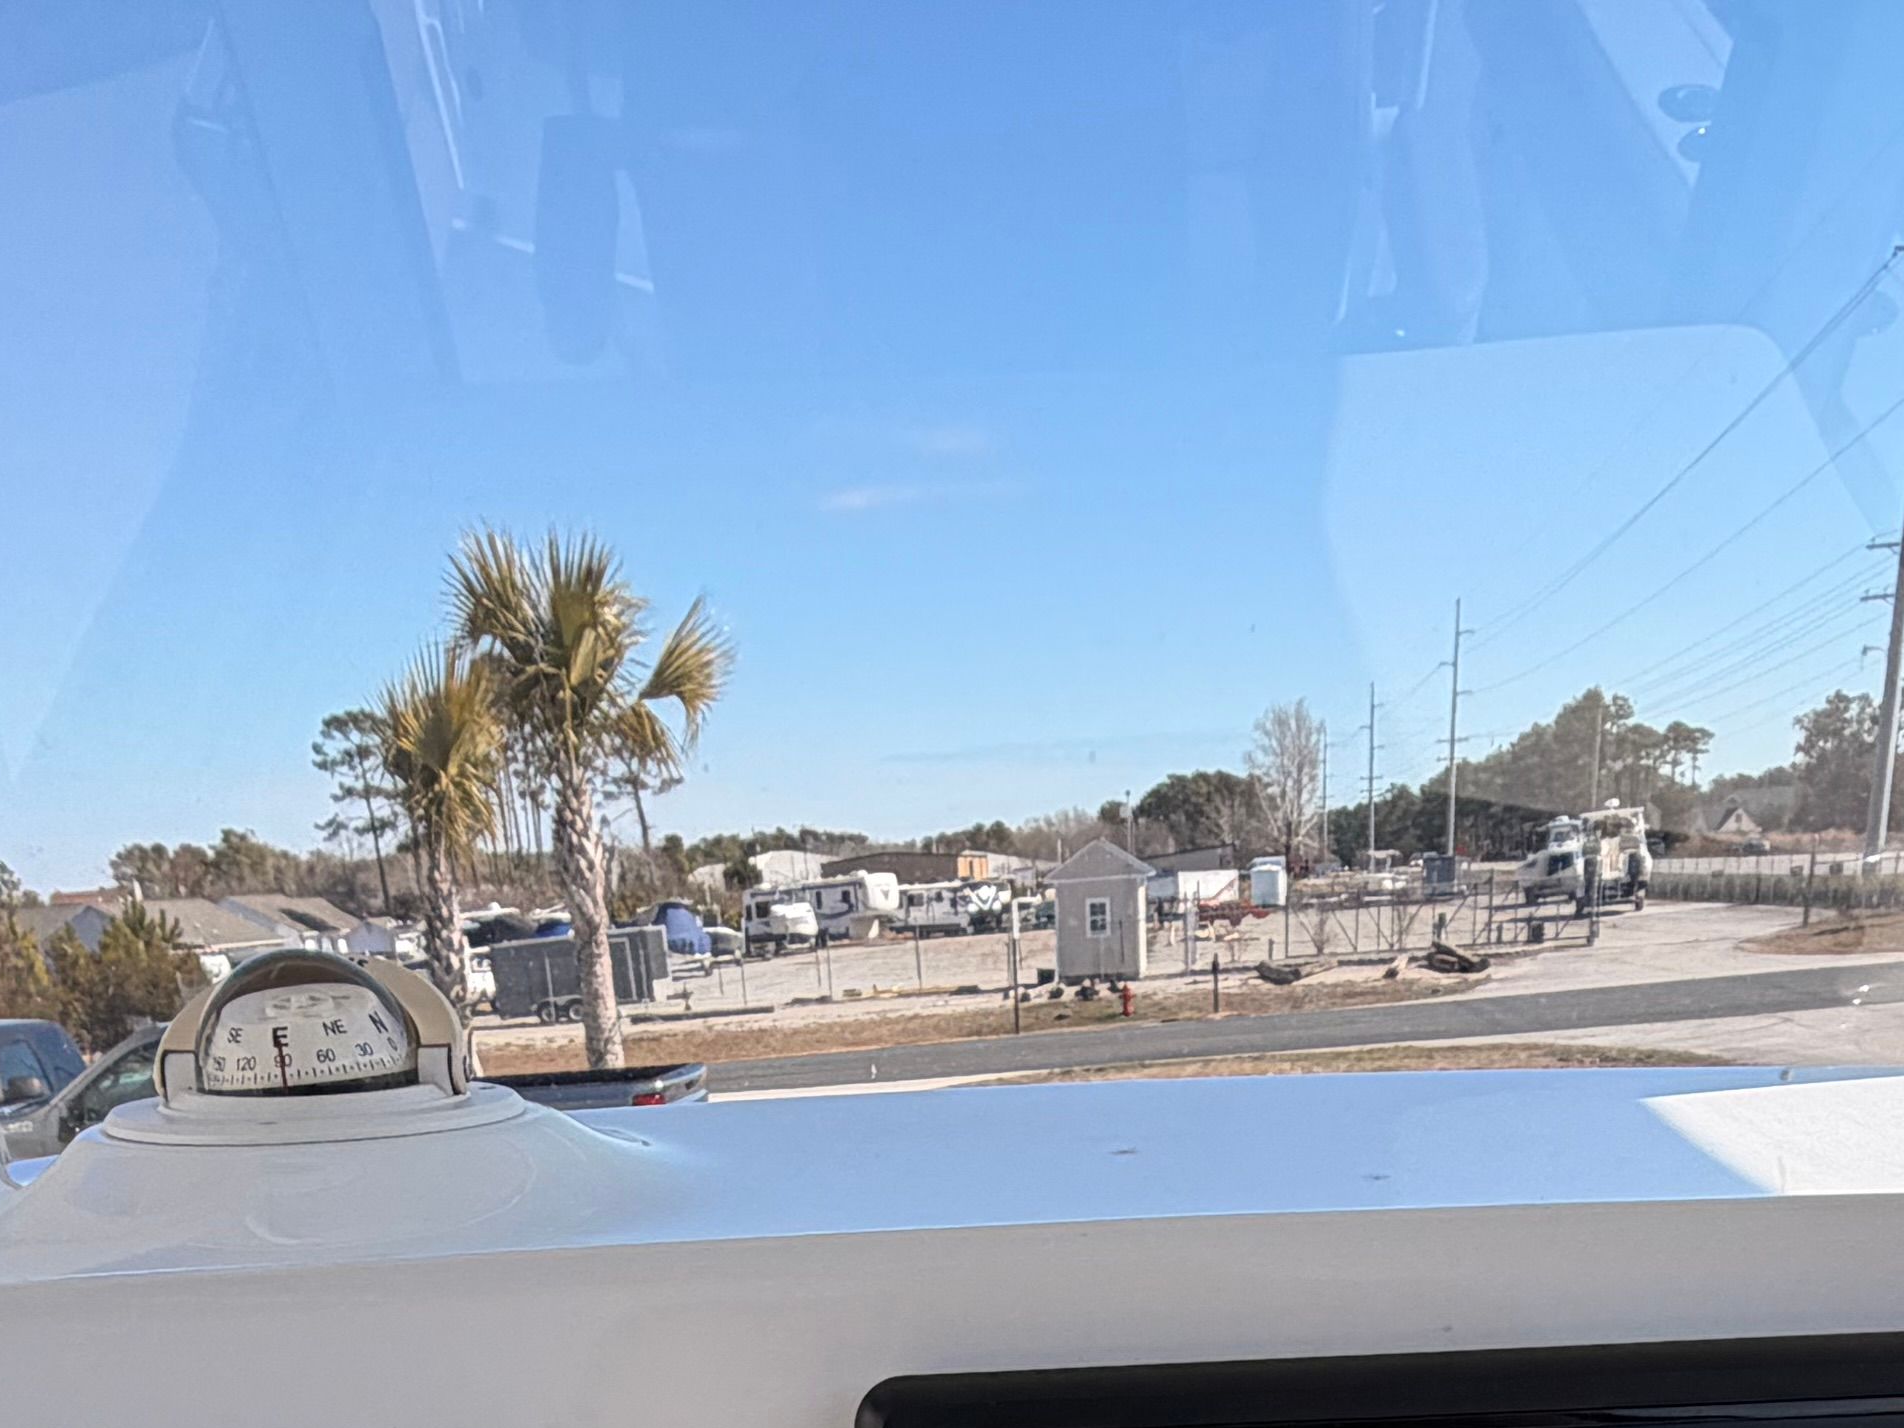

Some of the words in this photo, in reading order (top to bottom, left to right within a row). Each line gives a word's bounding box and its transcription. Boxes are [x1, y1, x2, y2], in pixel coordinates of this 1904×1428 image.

[227, 1027, 243, 1044] SE
[272, 1026, 289, 1048] E
[322, 1019, 347, 1036] NE
[369, 1011, 387, 1033] N
[236, 1056, 256, 1071] 120
[317, 1048, 336, 1063] 60
[355, 1043, 374, 1058] 30
